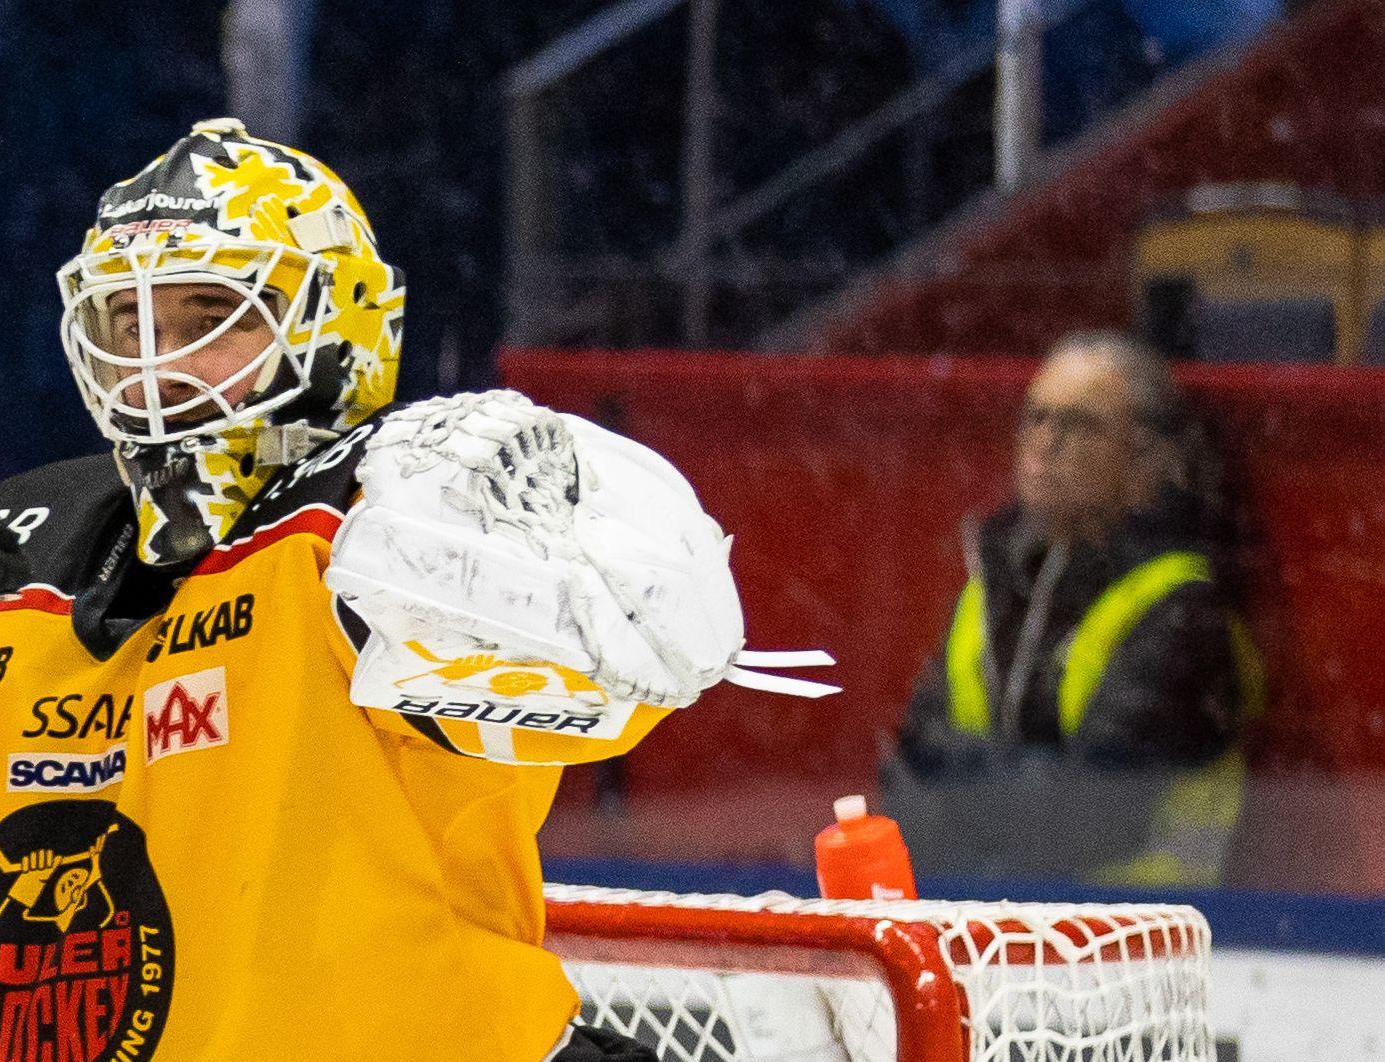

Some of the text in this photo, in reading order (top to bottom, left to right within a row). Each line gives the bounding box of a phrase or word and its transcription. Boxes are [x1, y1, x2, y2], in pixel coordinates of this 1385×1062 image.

[169, 596, 254, 657] LKAB
[146, 680, 223, 762] MAX
[392, 697, 600, 734] BAUER
[138, 924, 163, 997] 1977
